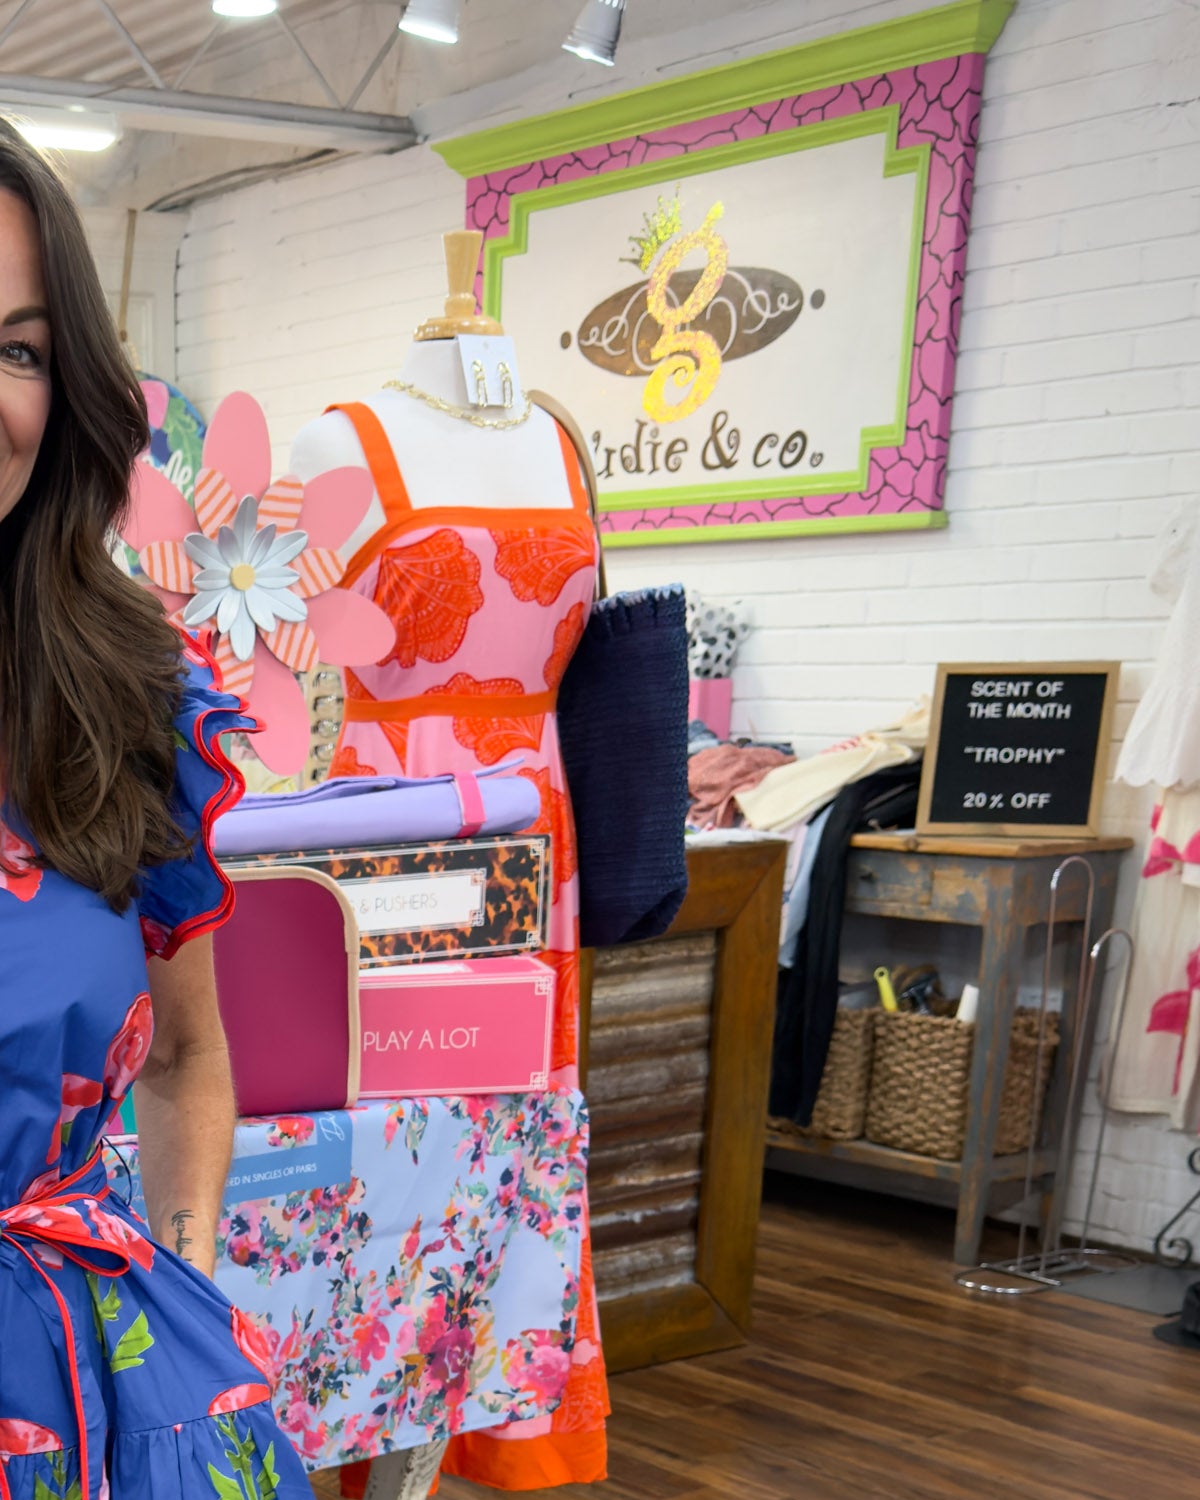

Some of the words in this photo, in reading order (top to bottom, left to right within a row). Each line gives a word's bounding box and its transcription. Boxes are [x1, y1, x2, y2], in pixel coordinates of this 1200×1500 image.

[701, 410, 740, 470] &
[753, 430, 824, 469] co.
[970, 681, 1033, 697] SCENT
[1036, 681, 1064, 697] OF
[967, 702, 1003, 718] THE
[1006, 702, 1071, 719] MONTH
[964, 747, 1065, 763] "TROPHY"
[1010, 792, 1051, 808] OFF
[374, 892, 438, 913] PUSHERS
[363, 1029, 413, 1052] PLAY
[418, 1029, 434, 1050] A
[439, 1027, 480, 1049] LOT
